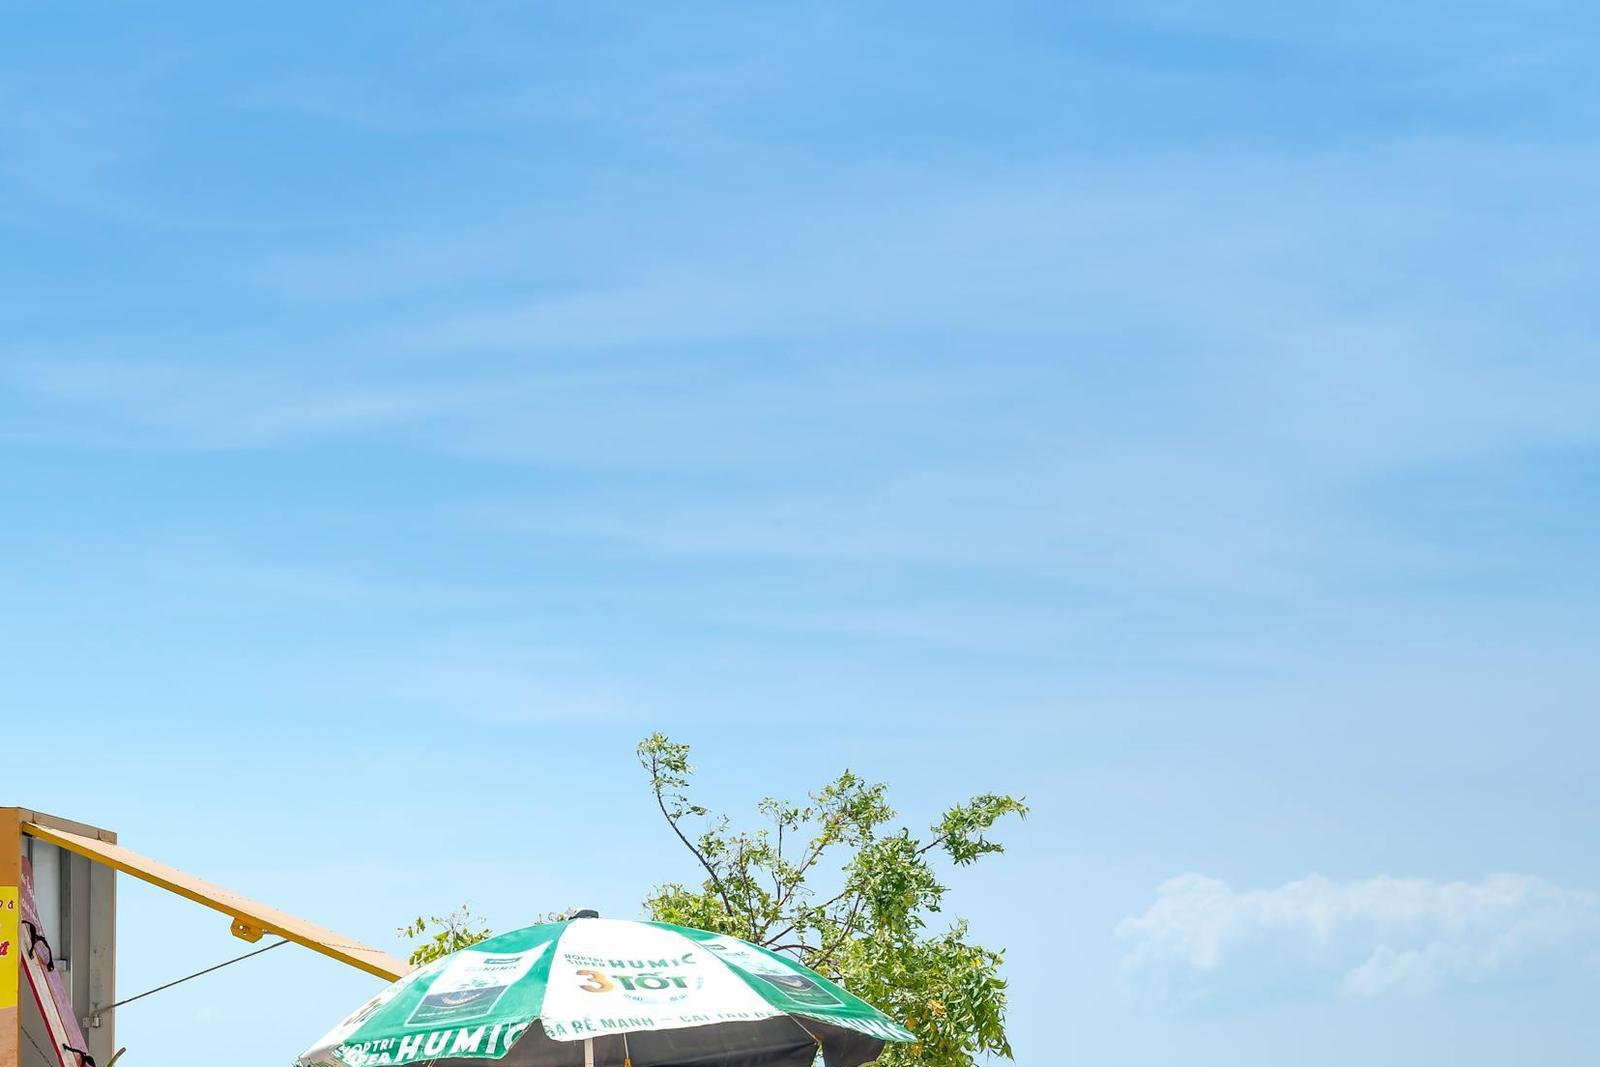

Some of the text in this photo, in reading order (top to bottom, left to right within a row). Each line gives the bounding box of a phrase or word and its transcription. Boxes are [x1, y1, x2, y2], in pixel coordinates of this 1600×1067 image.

[608, 952, 696, 969] HUMIC
[576, 969, 614, 993] 3
[395, 1021, 531, 1064] HUMIC
